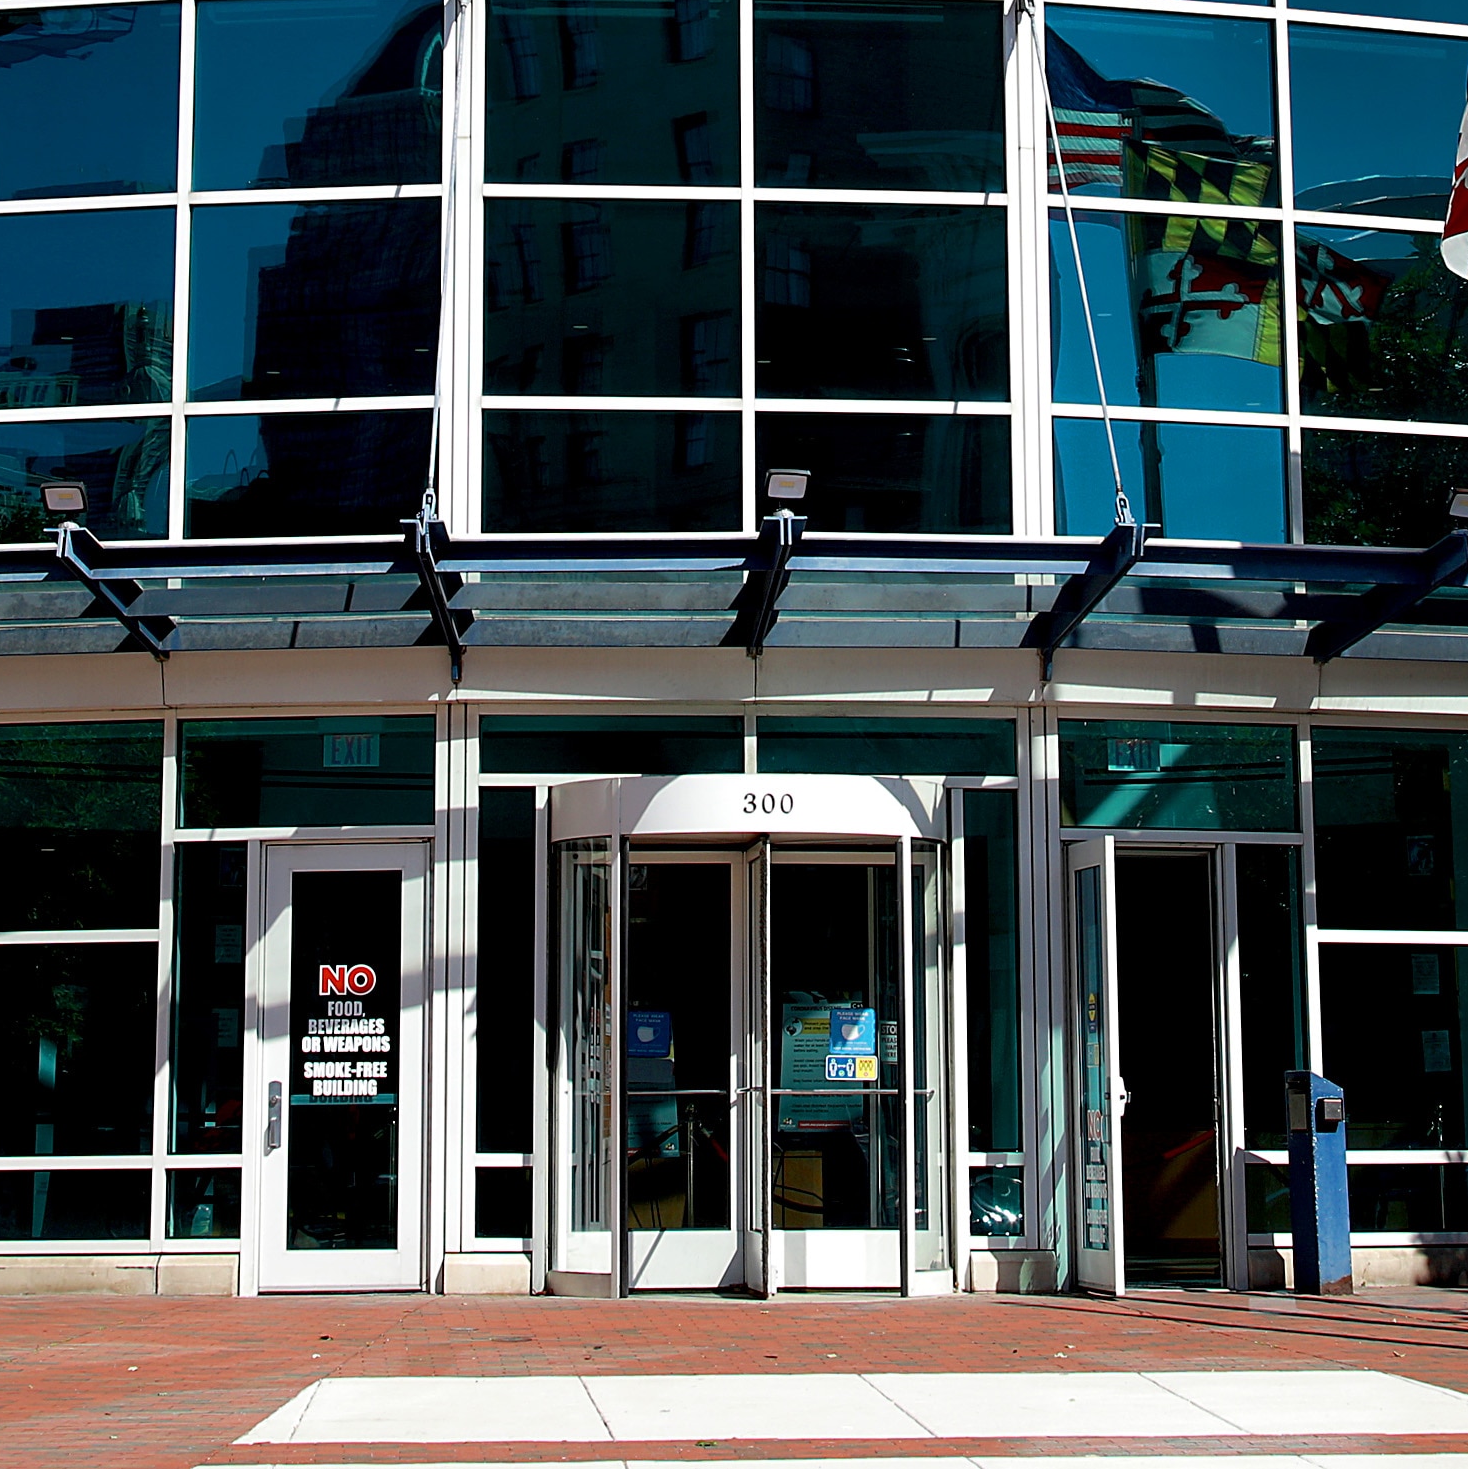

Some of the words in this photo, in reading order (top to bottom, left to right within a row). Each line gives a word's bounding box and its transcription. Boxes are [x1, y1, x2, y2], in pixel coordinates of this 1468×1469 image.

[331, 735, 373, 765] EXIT
[742, 792, 794, 814] 300
[318, 964, 377, 996] NO
[327, 1000, 366, 1018] FOOD,
[307, 1018, 385, 1035] BEVERAGES
[881, 1025, 897, 1034] STO
[301, 1036, 321, 1052] OR
[323, 1035, 391, 1052] WEAPONS
[303, 1061, 388, 1078] SMOKE-FREE
[312, 1079, 378, 1096] BUILDING
